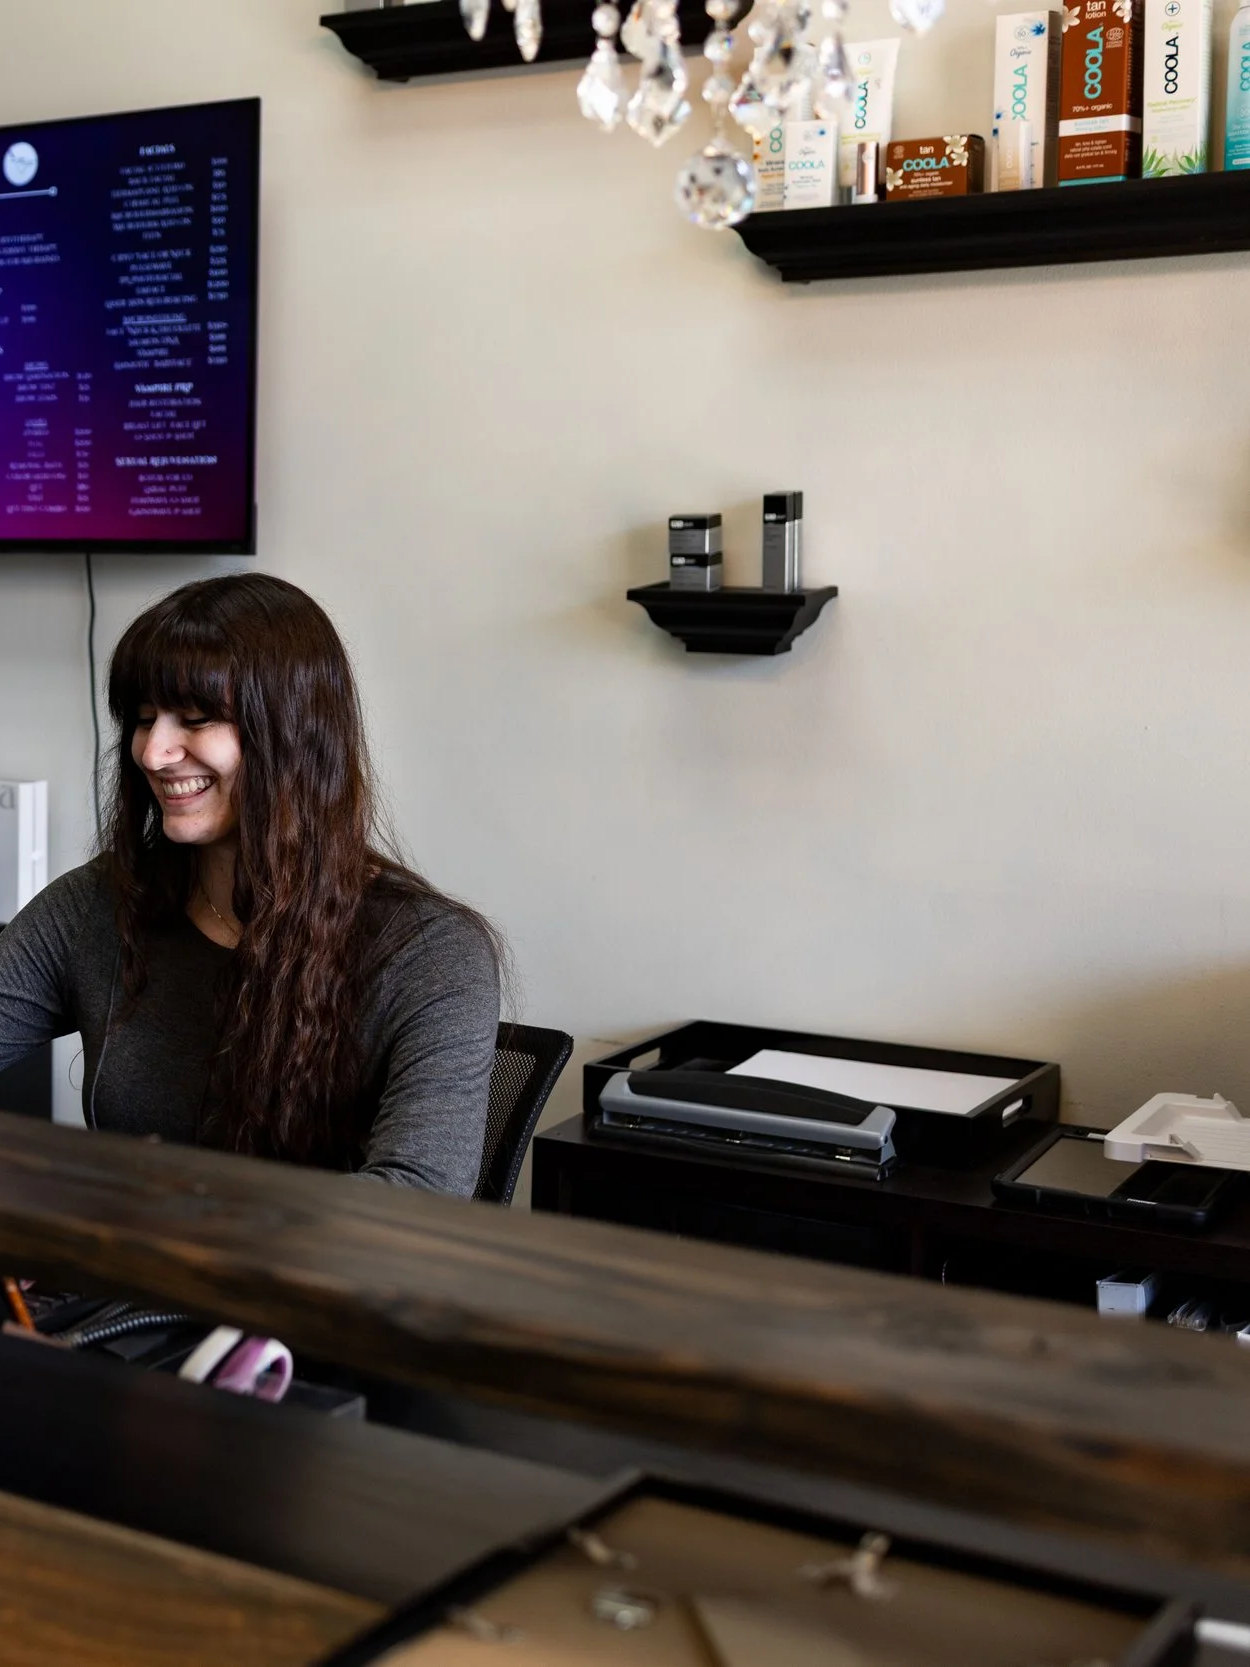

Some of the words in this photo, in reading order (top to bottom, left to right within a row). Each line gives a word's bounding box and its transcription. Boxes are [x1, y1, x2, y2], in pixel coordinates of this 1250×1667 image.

[1086, 1, 1106, 12] tan
[1085, 10, 1107, 20] lotion
[1084, 26, 1104, 99] COOLA
[1164, 35, 1179, 94] COOLA
[1091, 103, 1113, 111] organic
[919, 146, 934, 155] tan
[788, 159, 825, 171] COOLA
[902, 156, 949, 172] COOLA
